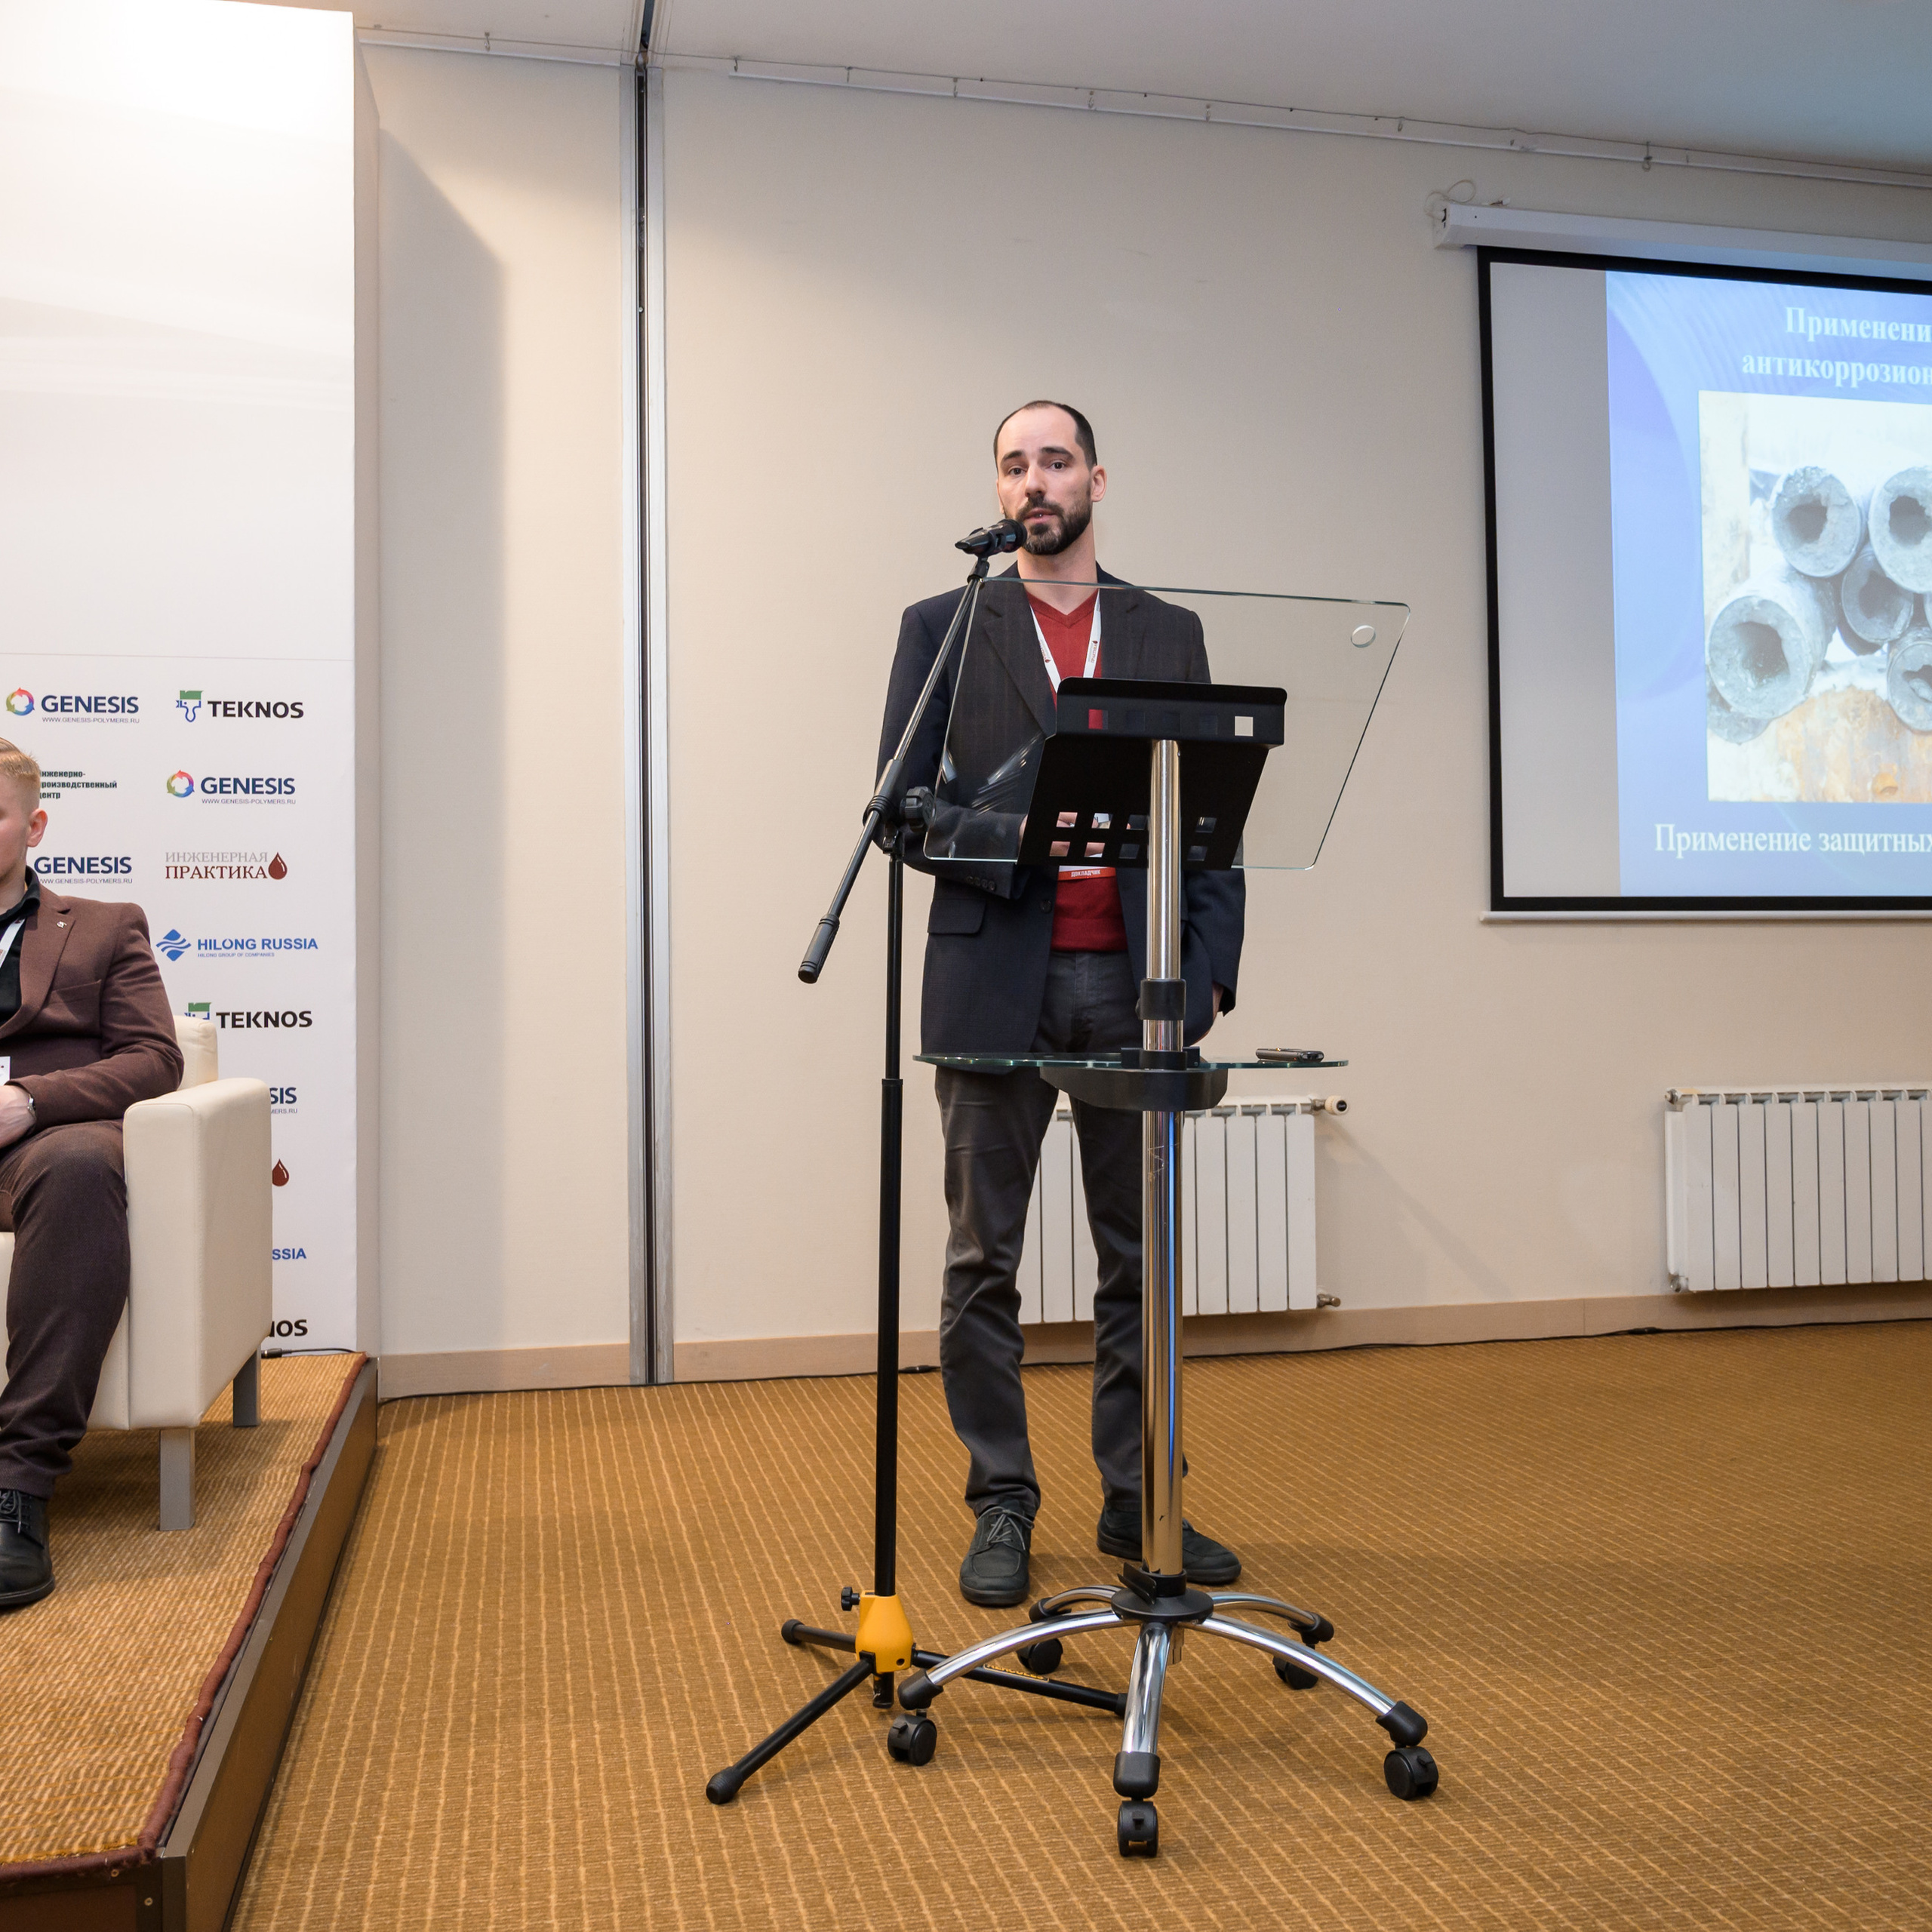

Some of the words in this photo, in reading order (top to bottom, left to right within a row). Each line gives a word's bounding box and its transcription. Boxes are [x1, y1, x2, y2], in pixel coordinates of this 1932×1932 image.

[1785, 306, 1932, 343] Применени
[41, 694, 139, 714] GENESIS
[208, 700, 304, 718] TEKNOS
[200, 777, 296, 795] GENESIS
[1654, 823, 1811, 859] Применение
[34, 857, 132, 874] GENESIS
[165, 852, 269, 863] ИНЖЕНЕРНАЯ
[165, 866, 268, 879] ПРАКТИКА
[198, 939, 257, 950] HILONG
[261, 938, 318, 950] RUSSIA
[216, 1011, 313, 1029] TEKNOS
